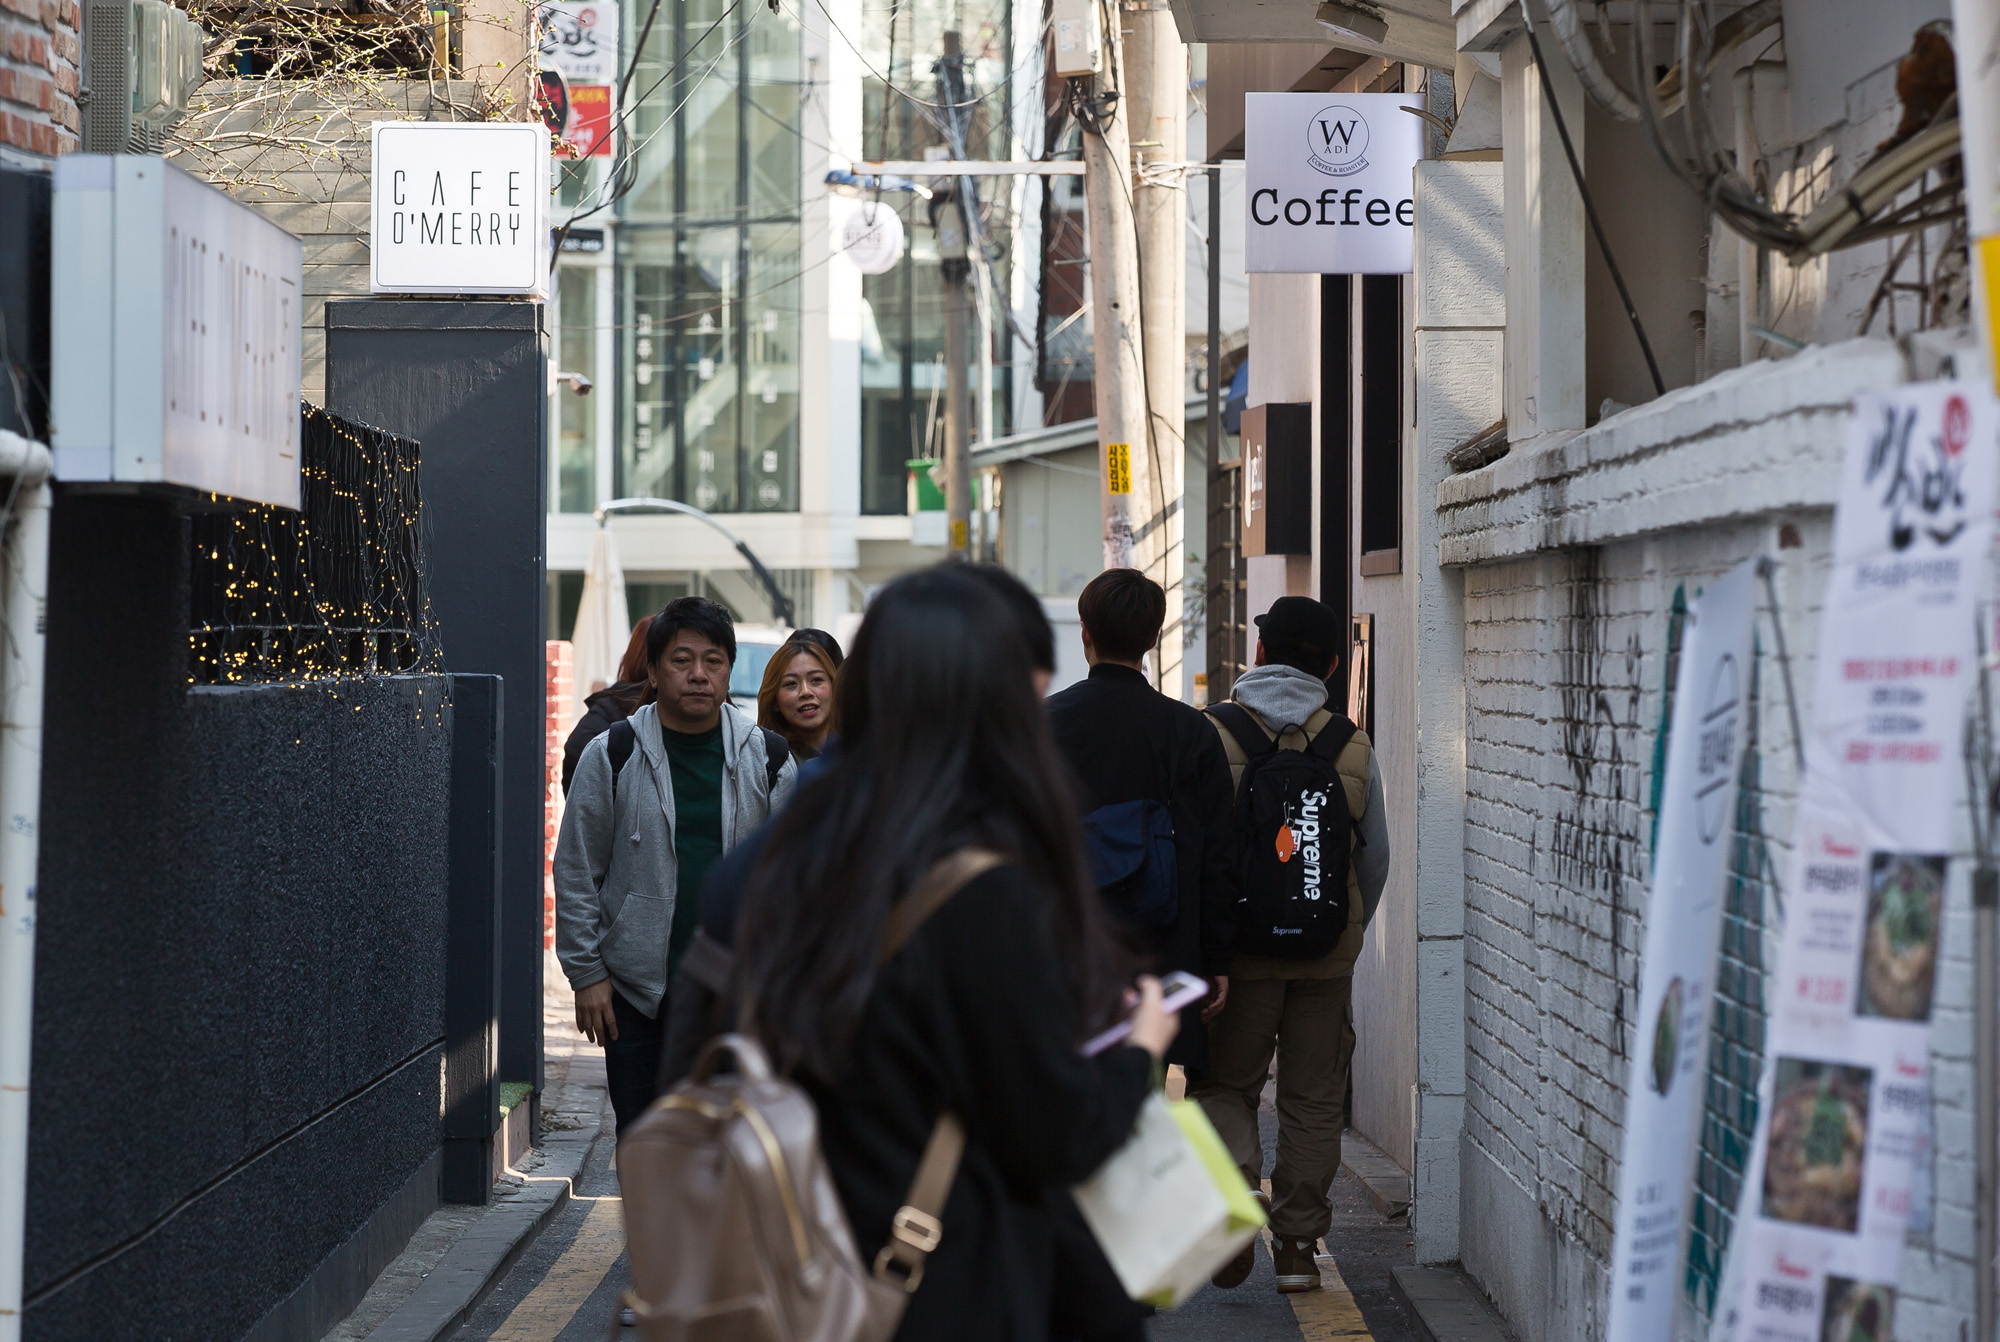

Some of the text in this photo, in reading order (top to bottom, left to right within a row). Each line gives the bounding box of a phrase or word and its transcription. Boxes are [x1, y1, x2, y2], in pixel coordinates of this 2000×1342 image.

[1311, 157, 1333, 172] COFFEE
[1339, 158, 1366, 173] ROASTER
[1324, 145, 1348, 154] ADI
[394, 170, 520, 207] CAFE
[1251, 188, 1414, 227] Coffee
[393, 211, 520, 246] O'MERRY
[1295, 789, 1328, 900] Supreme
[1272, 926, 1303, 936] Supreme
